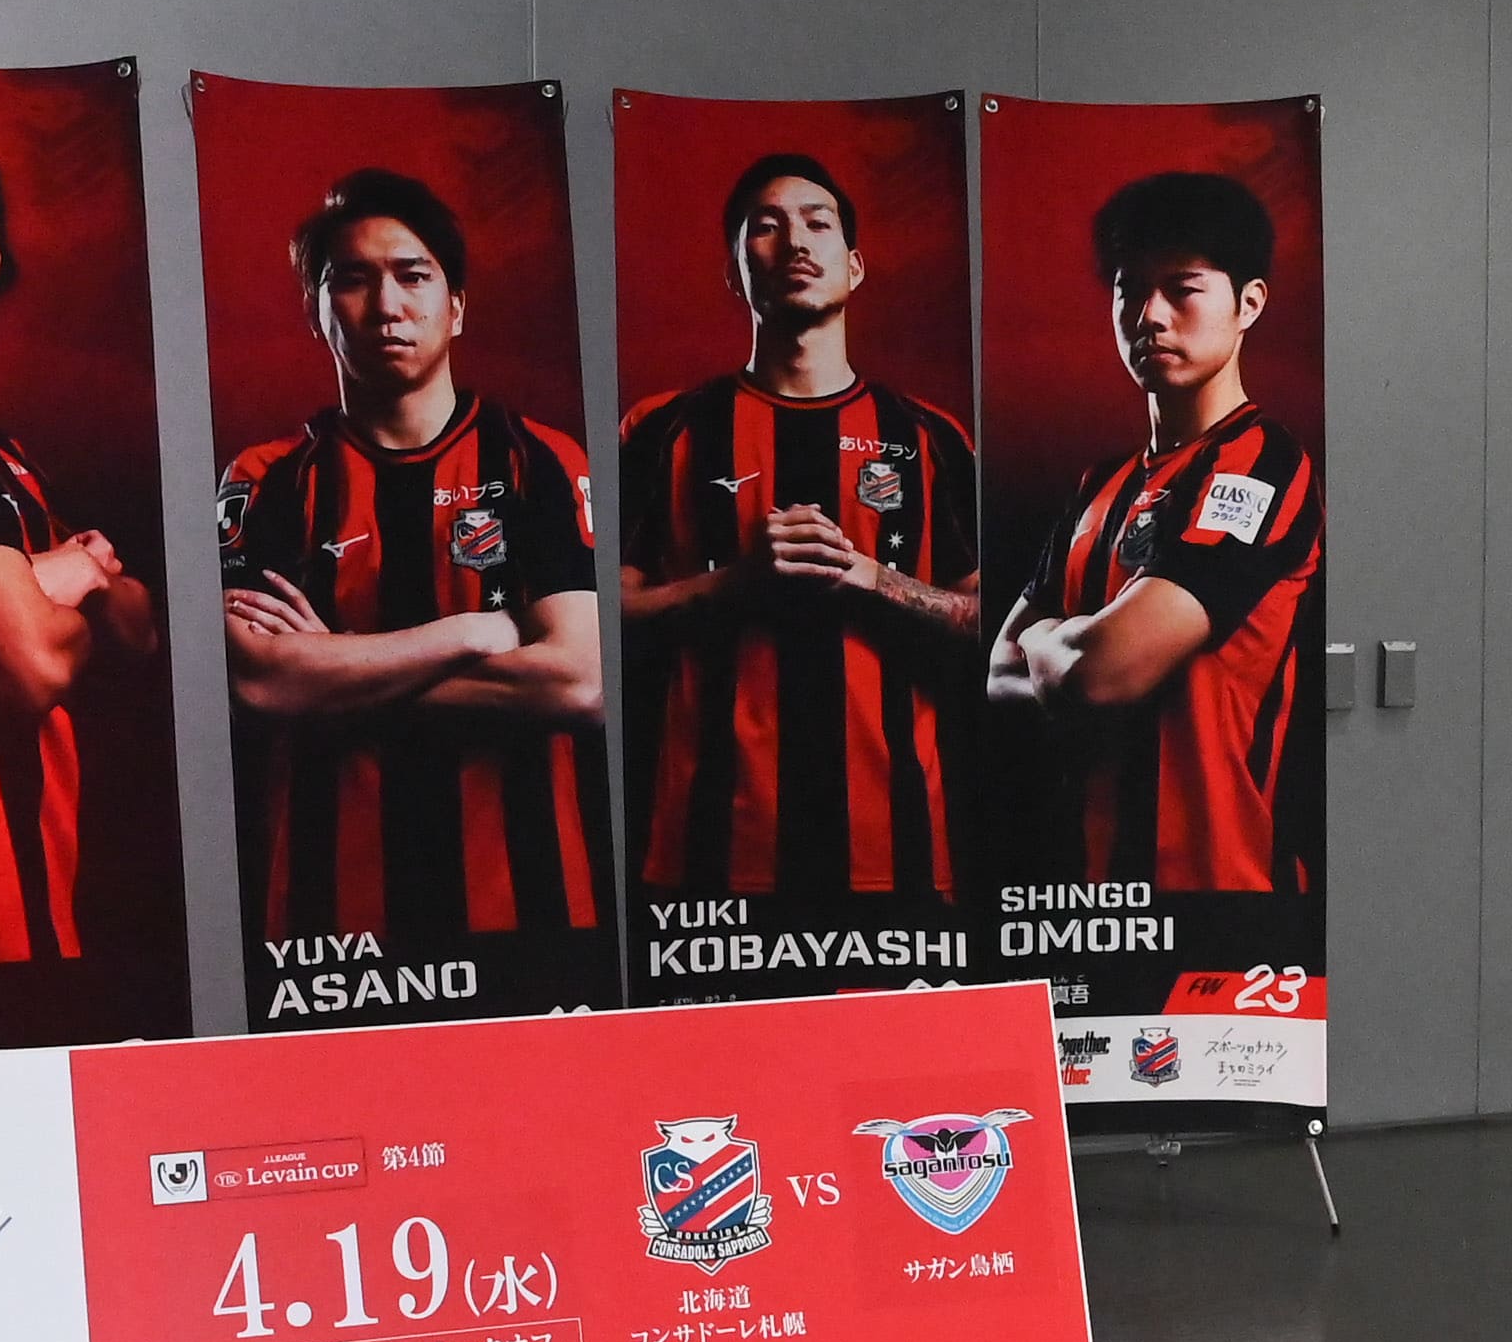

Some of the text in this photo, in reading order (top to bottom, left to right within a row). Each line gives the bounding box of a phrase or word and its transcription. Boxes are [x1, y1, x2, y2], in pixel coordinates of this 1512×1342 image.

[1000, 881, 1152, 913] SHINGO
[649, 898, 748, 930] YUKI
[264, 931, 384, 969] YUYA
[1000, 916, 1175, 957] OMORI
[649, 930, 968, 978] KOBAYASHI
[268, 960, 478, 1019] ASANO
[1186, 976, 1229, 997] FW
[1234, 964, 1307, 1013] 23
[382, 1141, 446, 1172] 第4節
[246, 1162, 319, 1187] Levain
[322, 1162, 360, 1180] CUP
[653, 1160, 695, 1193] CS
[651, 1230, 766, 1260] CONSADOLE SAPPORO
[676, 1224, 741, 1241] HOKKAIDO
[903, 1250, 1015, 1284] サガン鳥栖
[678, 1284, 751, 1315] 北海道
